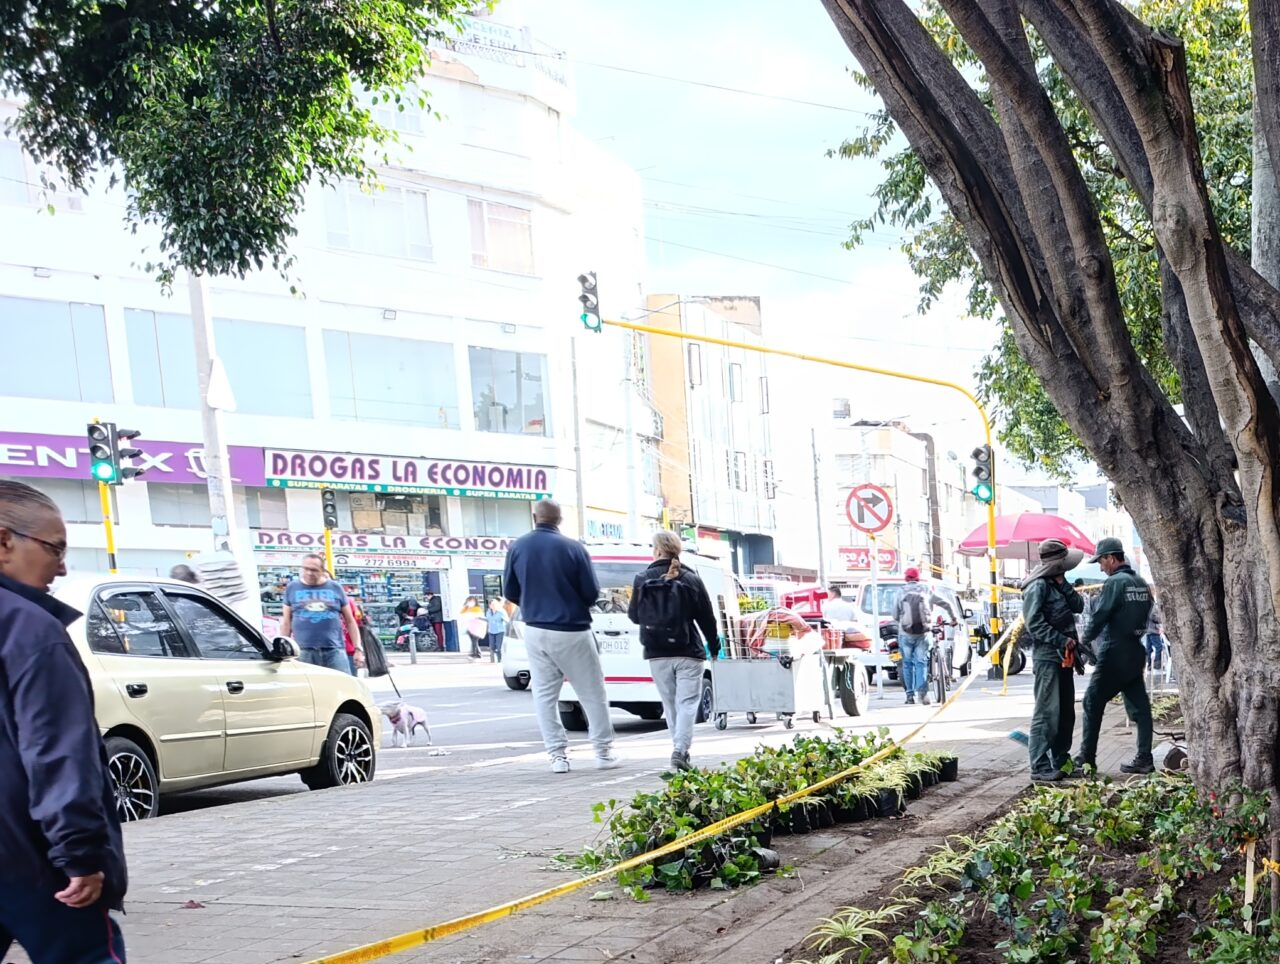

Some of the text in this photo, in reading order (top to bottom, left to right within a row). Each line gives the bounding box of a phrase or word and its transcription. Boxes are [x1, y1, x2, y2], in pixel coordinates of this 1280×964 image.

[272, 453, 547, 490] DROGAS LA ECONOMIA
[466, 490, 496, 498] SUPER
[497, 491, 537, 500] BARATAS
[258, 532, 369, 547] DROGAS
[380, 536, 407, 549] LA
[364, 559, 384, 567] 272
